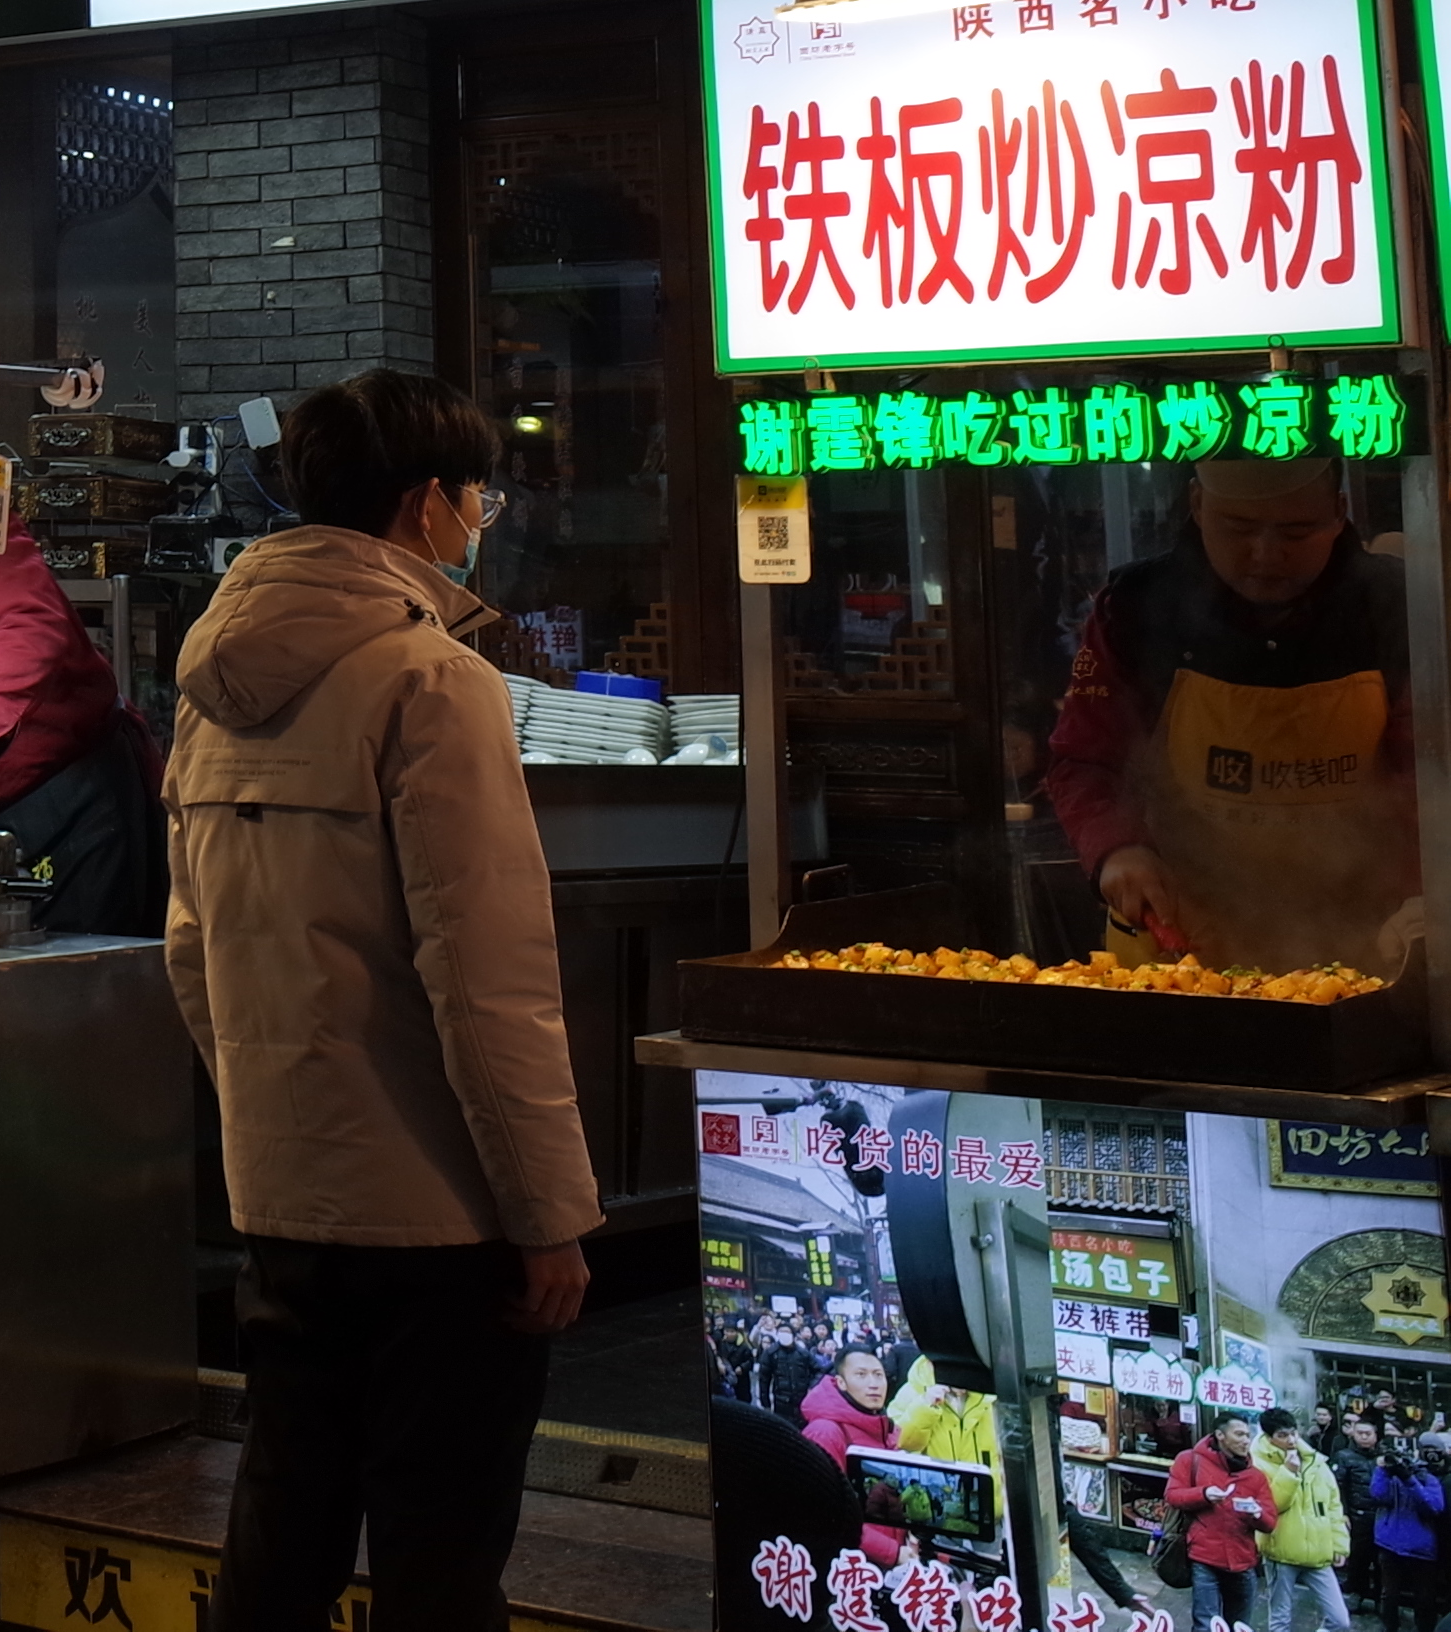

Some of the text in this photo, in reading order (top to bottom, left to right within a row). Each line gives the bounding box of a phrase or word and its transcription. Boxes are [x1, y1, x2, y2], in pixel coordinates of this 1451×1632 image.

[742, 54, 1363, 315] 铁板炒凉粉
[739, 376, 1406, 477] 谢霆锋吃过的炒凉粉
[1260, 754, 1358, 790] 收钱吧
[805, 1120, 1045, 1189] 吃货的最爱
[1122, 1365, 1184, 1397] 炒凉粉
[1203, 1379, 1274, 1410] 灌汤包子
[752, 1536, 1255, 1632] 谢霆锋吃
